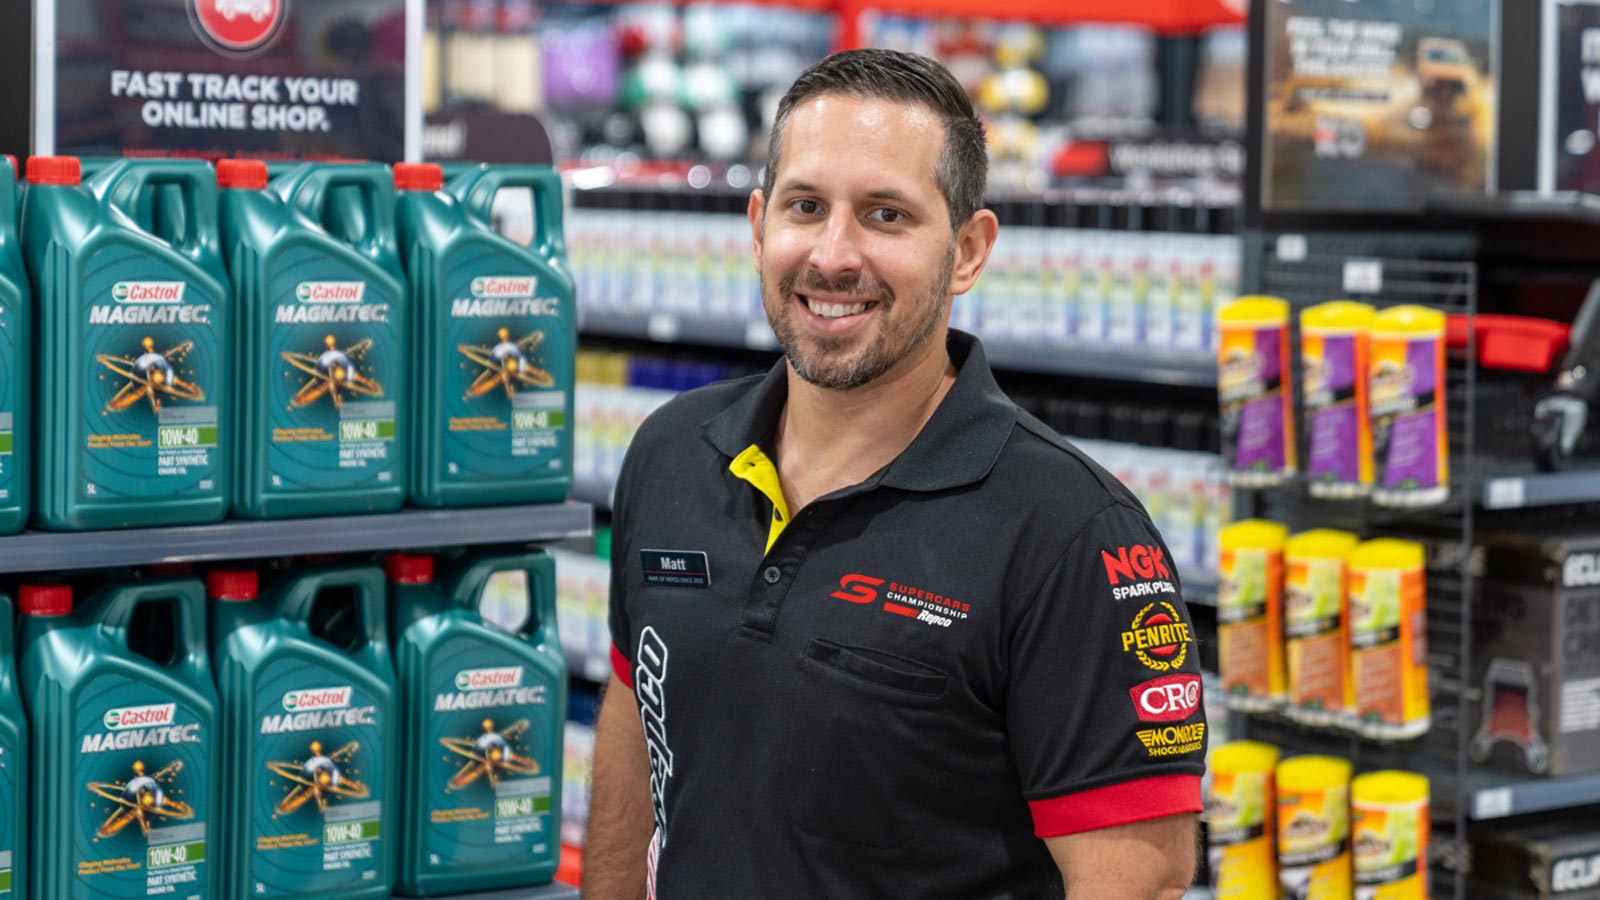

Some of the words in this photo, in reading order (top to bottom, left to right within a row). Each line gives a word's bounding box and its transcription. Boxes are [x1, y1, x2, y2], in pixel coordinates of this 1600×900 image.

[111, 70, 182, 97] FAST
[187, 73, 281, 101] TRACK
[285, 76, 359, 105] YOUR
[142, 101, 245, 129] ONLINE
[251, 107, 330, 132] SHOP.
[130, 284, 179, 300] Castrol
[312, 284, 358, 300] Castrol
[486, 279, 530, 294] Castrol
[90, 305, 211, 324] MAGNATEC
[275, 304, 389, 323] MAGNATEC
[452, 298, 558, 316] MAGNATEC
[514, 411, 548, 428] 10W-40
[161, 428, 198, 446] 10W-40
[342, 422, 377, 439] 10W-40
[158, 456, 175, 466] PART
[660, 556, 687, 571] Matt
[1101, 544, 1170, 585] NGK
[888, 582, 970, 612] SUPERCARS
[1113, 582, 1154, 600] SPARK
[886, 591, 968, 620] CHAMPIONSHIP
[917, 609, 953, 627] Repco
[1121, 623, 1192, 652] PENRITE
[471, 671, 516, 687] Castrol
[299, 689, 344, 708] Castrol
[435, 686, 545, 711] MAGNATEC
[1140, 681, 1199, 714] CRC
[121, 707, 170, 726] Castrol
[261, 706, 375, 734] MAGNATEC
[81, 724, 201, 753] MAGNATEC
[1151, 723, 1204, 746] MONROE
[1148, 745, 1177, 757] SHOCK
[498, 799, 532, 817] 10W-40
[327, 825, 361, 843] 10W-40
[150, 846, 186, 865] 10W-40
[147, 875, 164, 887] PART
